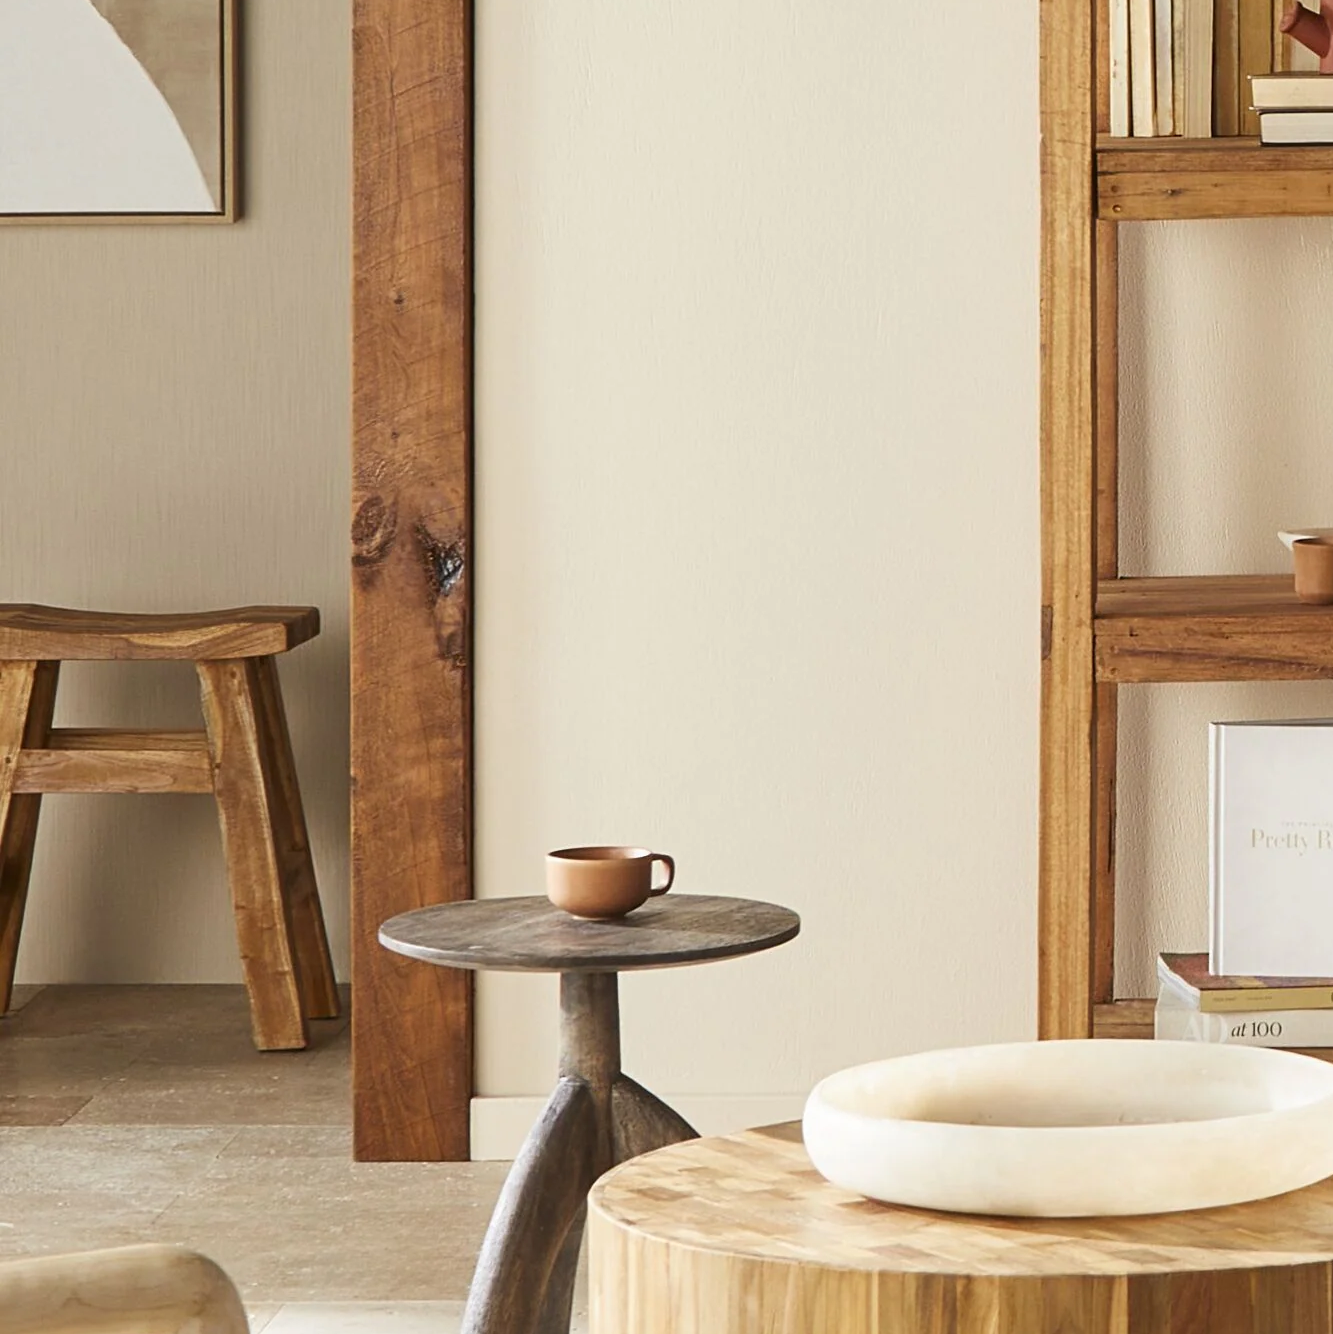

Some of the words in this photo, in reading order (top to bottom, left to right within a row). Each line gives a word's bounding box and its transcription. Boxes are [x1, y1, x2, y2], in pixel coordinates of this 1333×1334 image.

[1250, 828, 1308, 856] Pretty
[1231, 1022, 1248, 1037] at
[1251, 1022, 1283, 1037] 100
